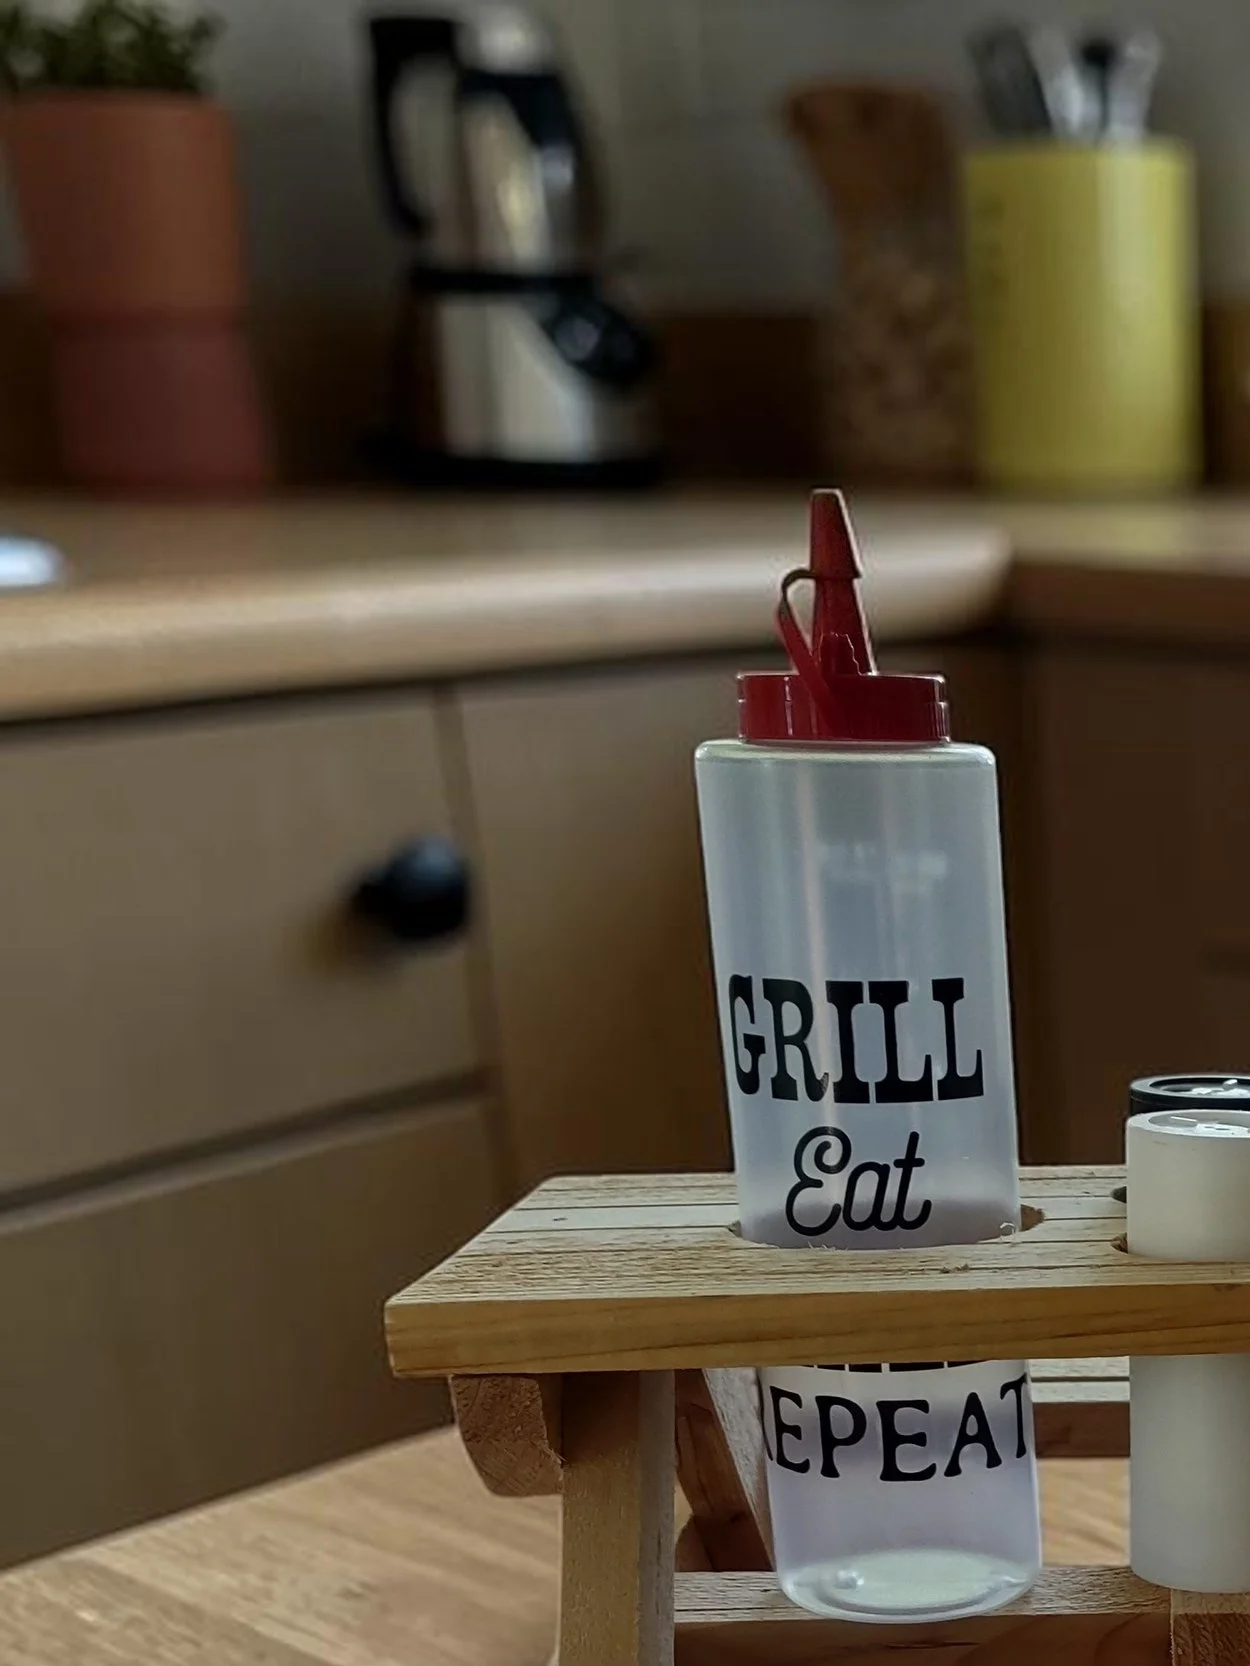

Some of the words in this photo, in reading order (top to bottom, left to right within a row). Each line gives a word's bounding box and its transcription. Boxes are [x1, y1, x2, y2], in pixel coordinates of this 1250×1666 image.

[729, 974, 984, 1104] GRILL
[785, 1125, 932, 1237] Eat
[758, 1373, 1028, 1482] EPEAT
